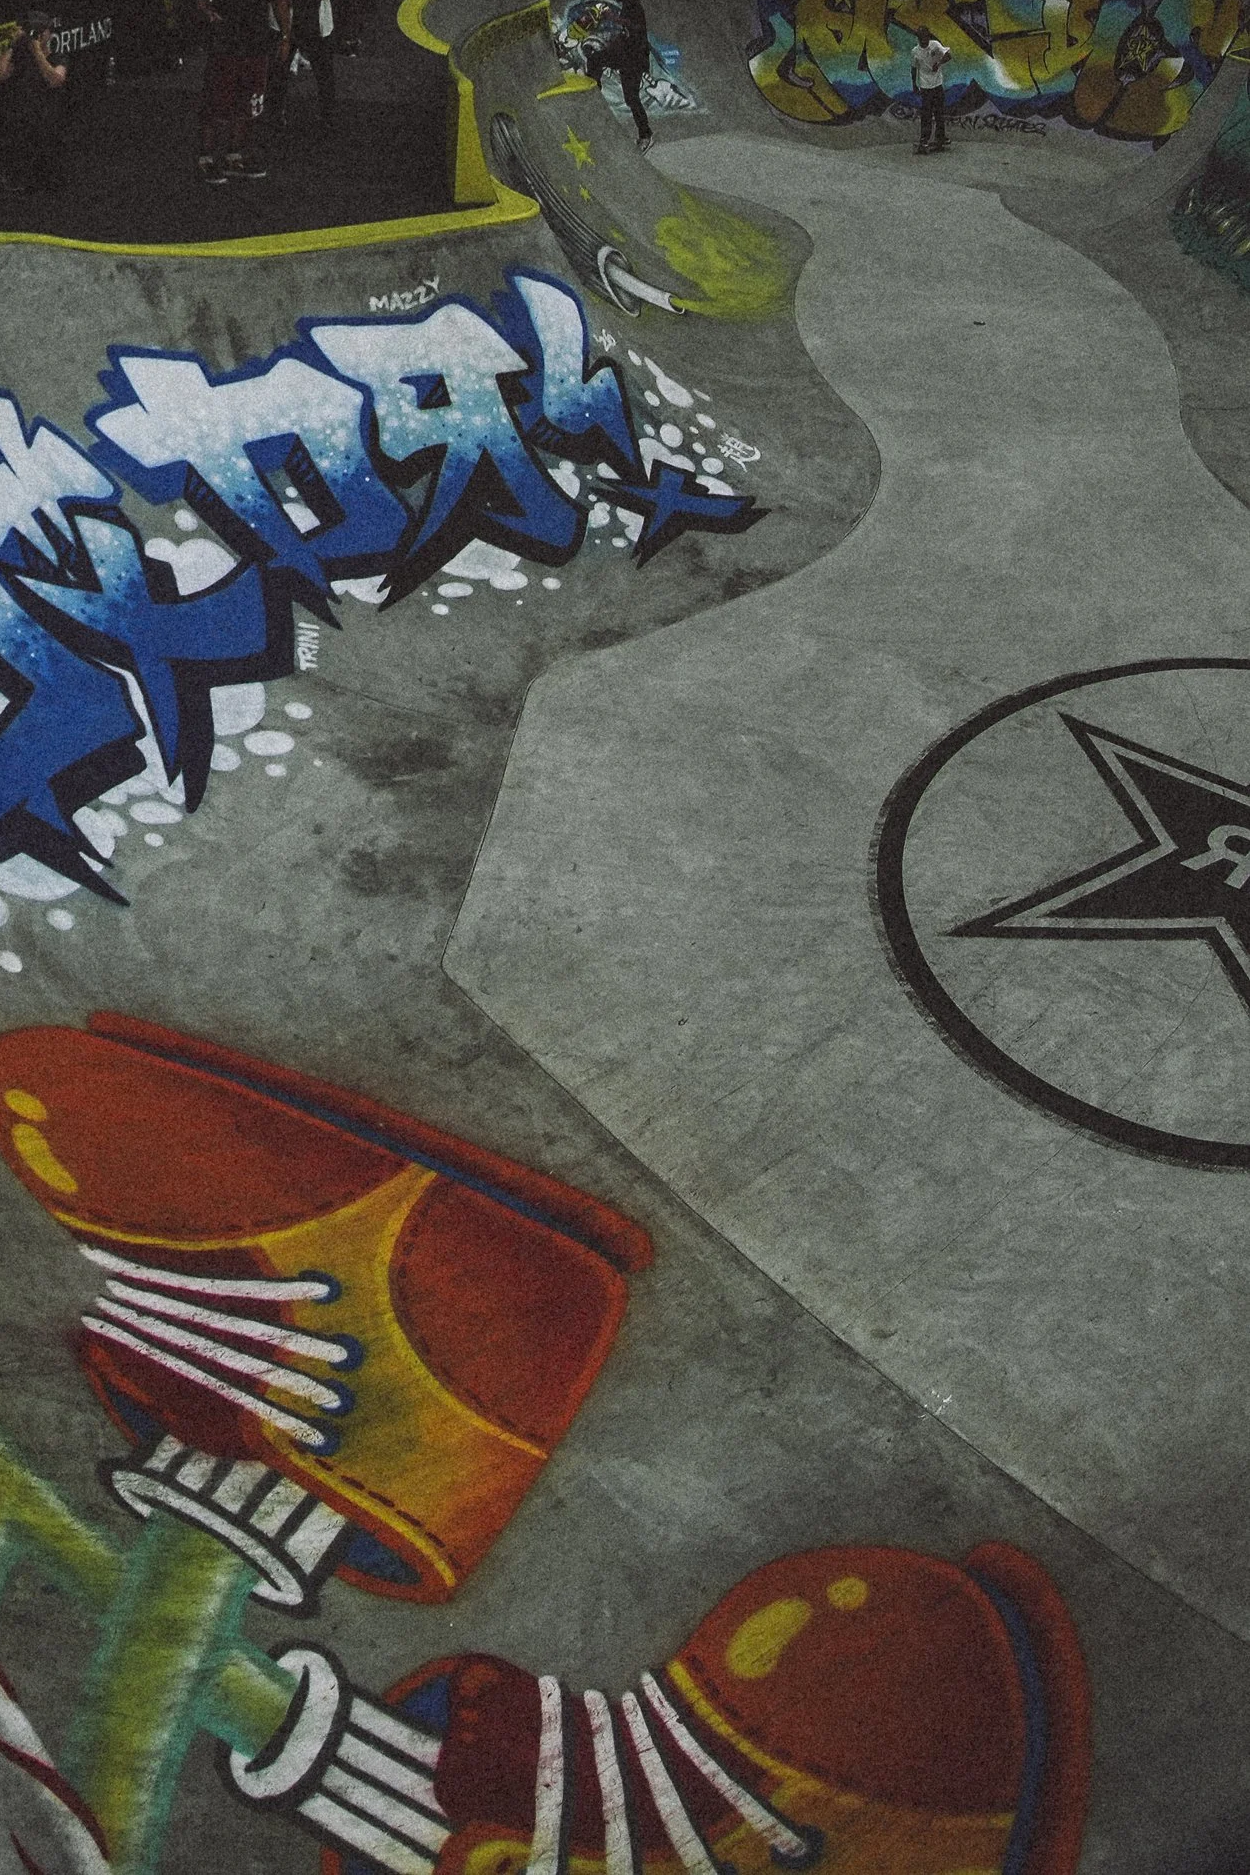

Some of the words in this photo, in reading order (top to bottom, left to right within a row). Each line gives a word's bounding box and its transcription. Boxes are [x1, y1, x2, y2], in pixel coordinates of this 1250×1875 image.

[47, 17, 114, 55] ORTLAND
[369, 275, 440, 312] MAZZY
[297, 621, 321, 672] TRINI
